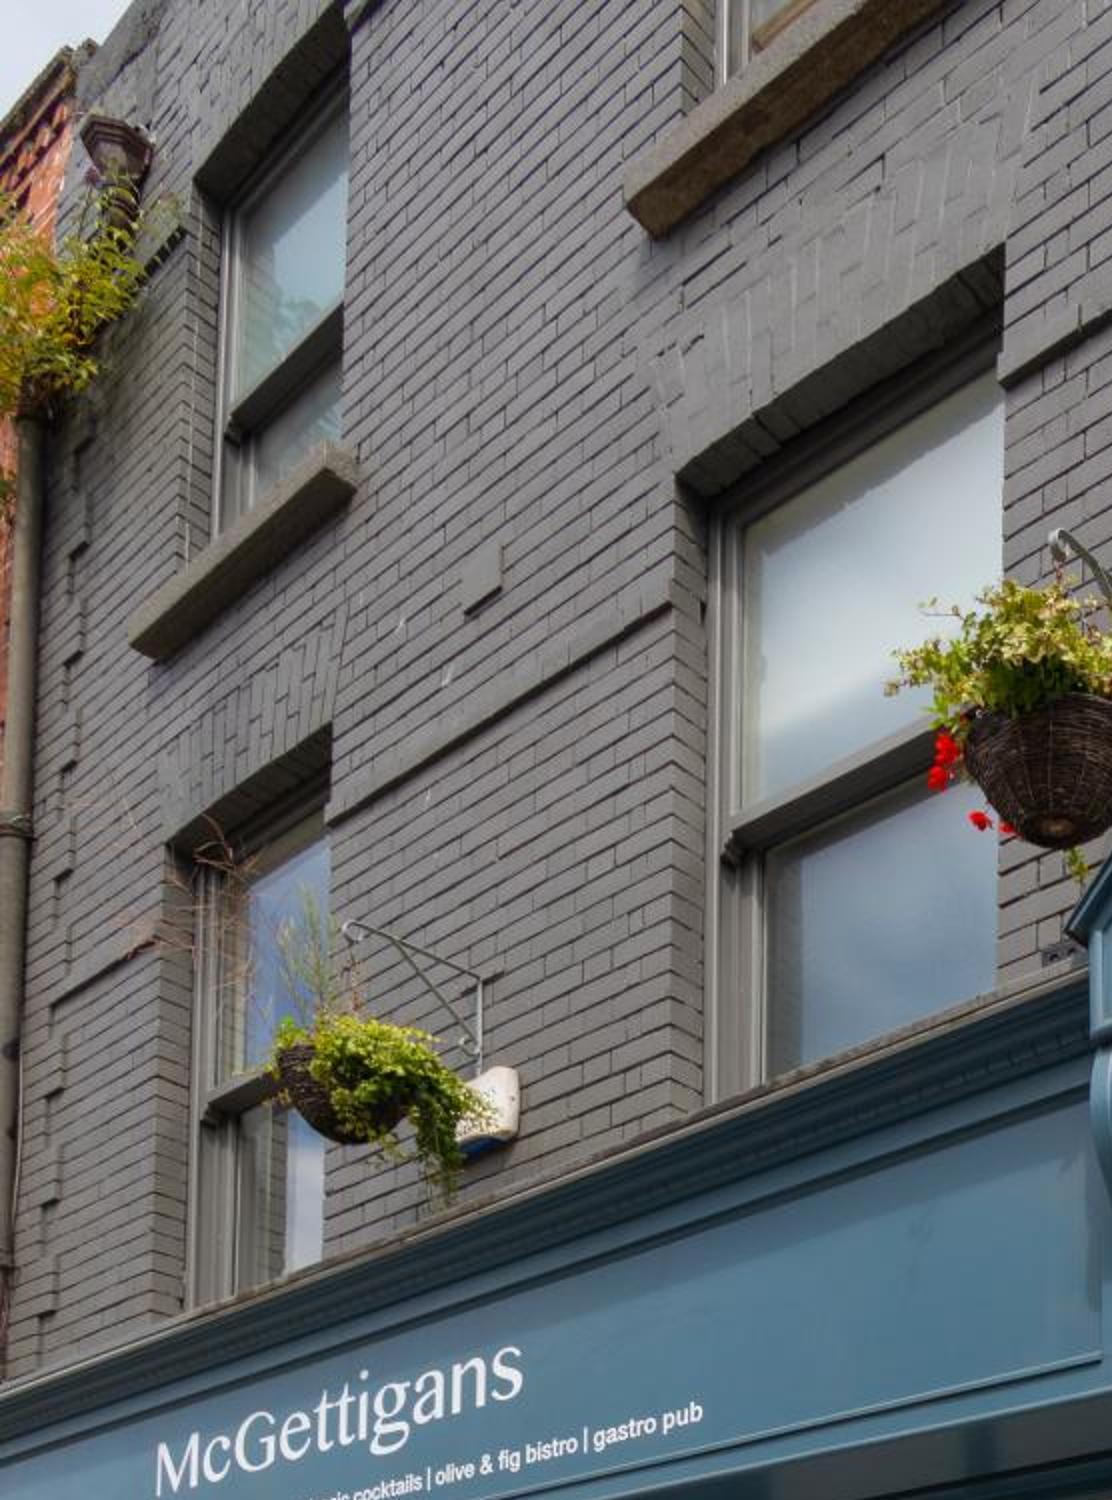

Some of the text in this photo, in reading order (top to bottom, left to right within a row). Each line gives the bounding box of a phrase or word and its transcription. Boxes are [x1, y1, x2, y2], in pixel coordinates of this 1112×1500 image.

[155, 1346, 524, 1498] McGettigans
[435, 1461, 475, 1487] olive
[479, 1453, 494, 1475] &
[498, 1448, 521, 1473] fig
[525, 1435, 577, 1464] bistro
[593, 1414, 657, 1450] gastro
[663, 1401, 704, 1434] pub
